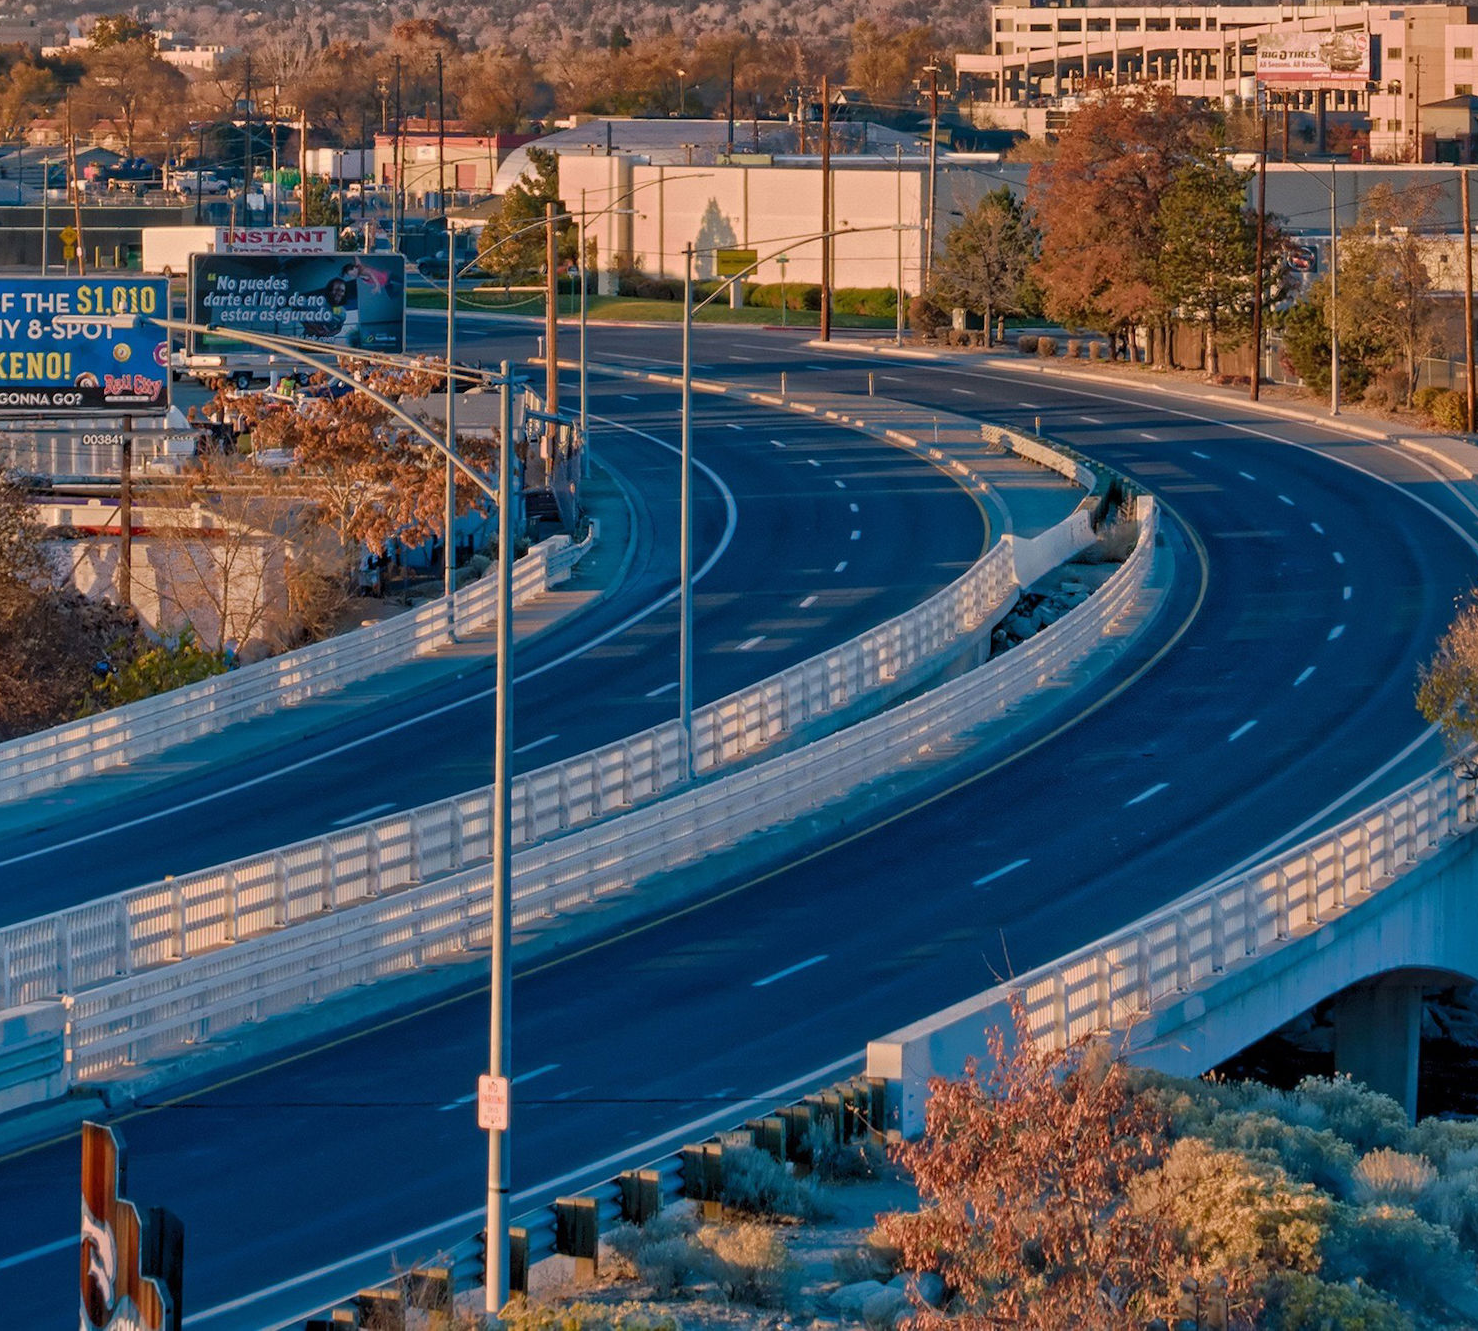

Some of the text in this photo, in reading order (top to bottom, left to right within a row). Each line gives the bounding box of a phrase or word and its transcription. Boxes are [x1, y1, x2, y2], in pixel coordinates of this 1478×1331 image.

[1262, 50, 1278, 59] BIG
[1289, 50, 1317, 59] TIRES
[222, 231, 327, 243] INSTANT
[238, 277, 289, 293] puedes
[21, 292, 71, 314] THE
[76, 284, 157, 316] $1,010
[203, 292, 324, 309] darte el lujo de no
[220, 310, 256, 321] estar
[133, 373, 163, 402] City
[51, 392, 84, 407] GO?
[82, 434, 123, 445] 003841
